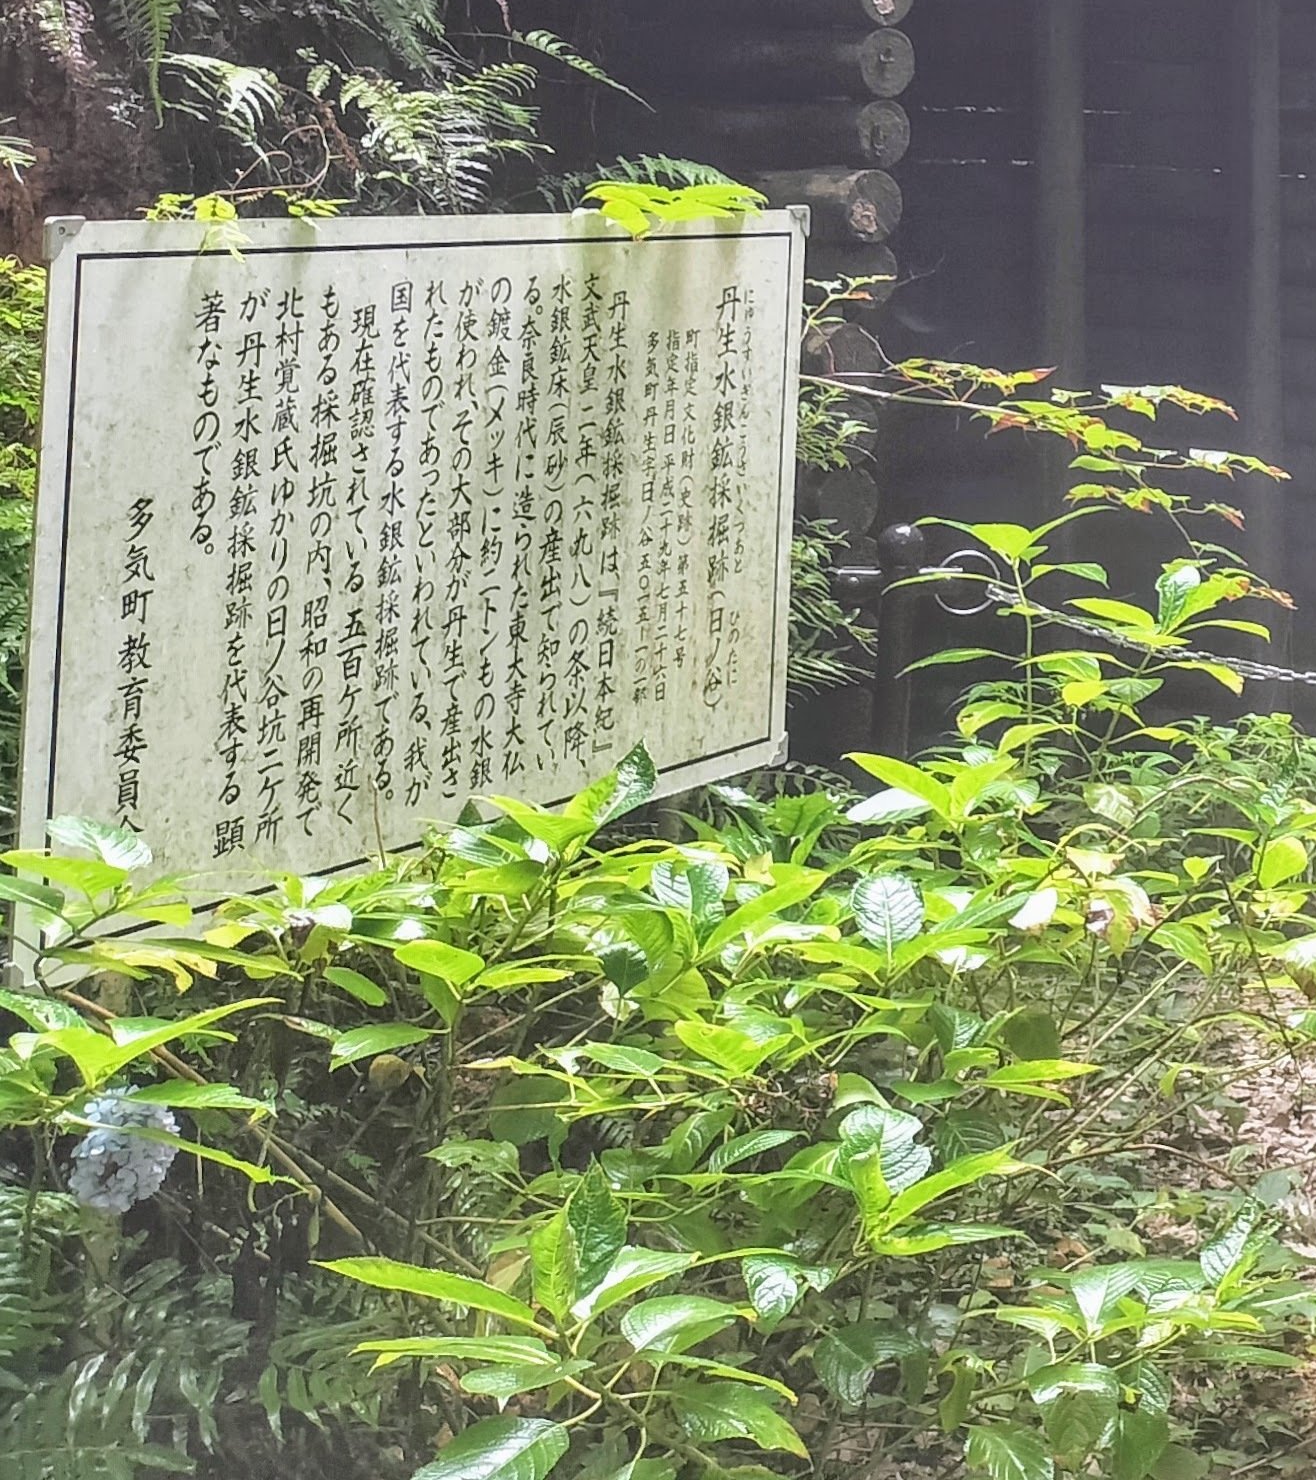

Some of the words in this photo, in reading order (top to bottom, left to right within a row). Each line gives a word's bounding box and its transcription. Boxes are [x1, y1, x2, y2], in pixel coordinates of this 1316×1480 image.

[190, 289, 226, 556] 著なものである。
[726, 609, 741, 687] ひのたに
